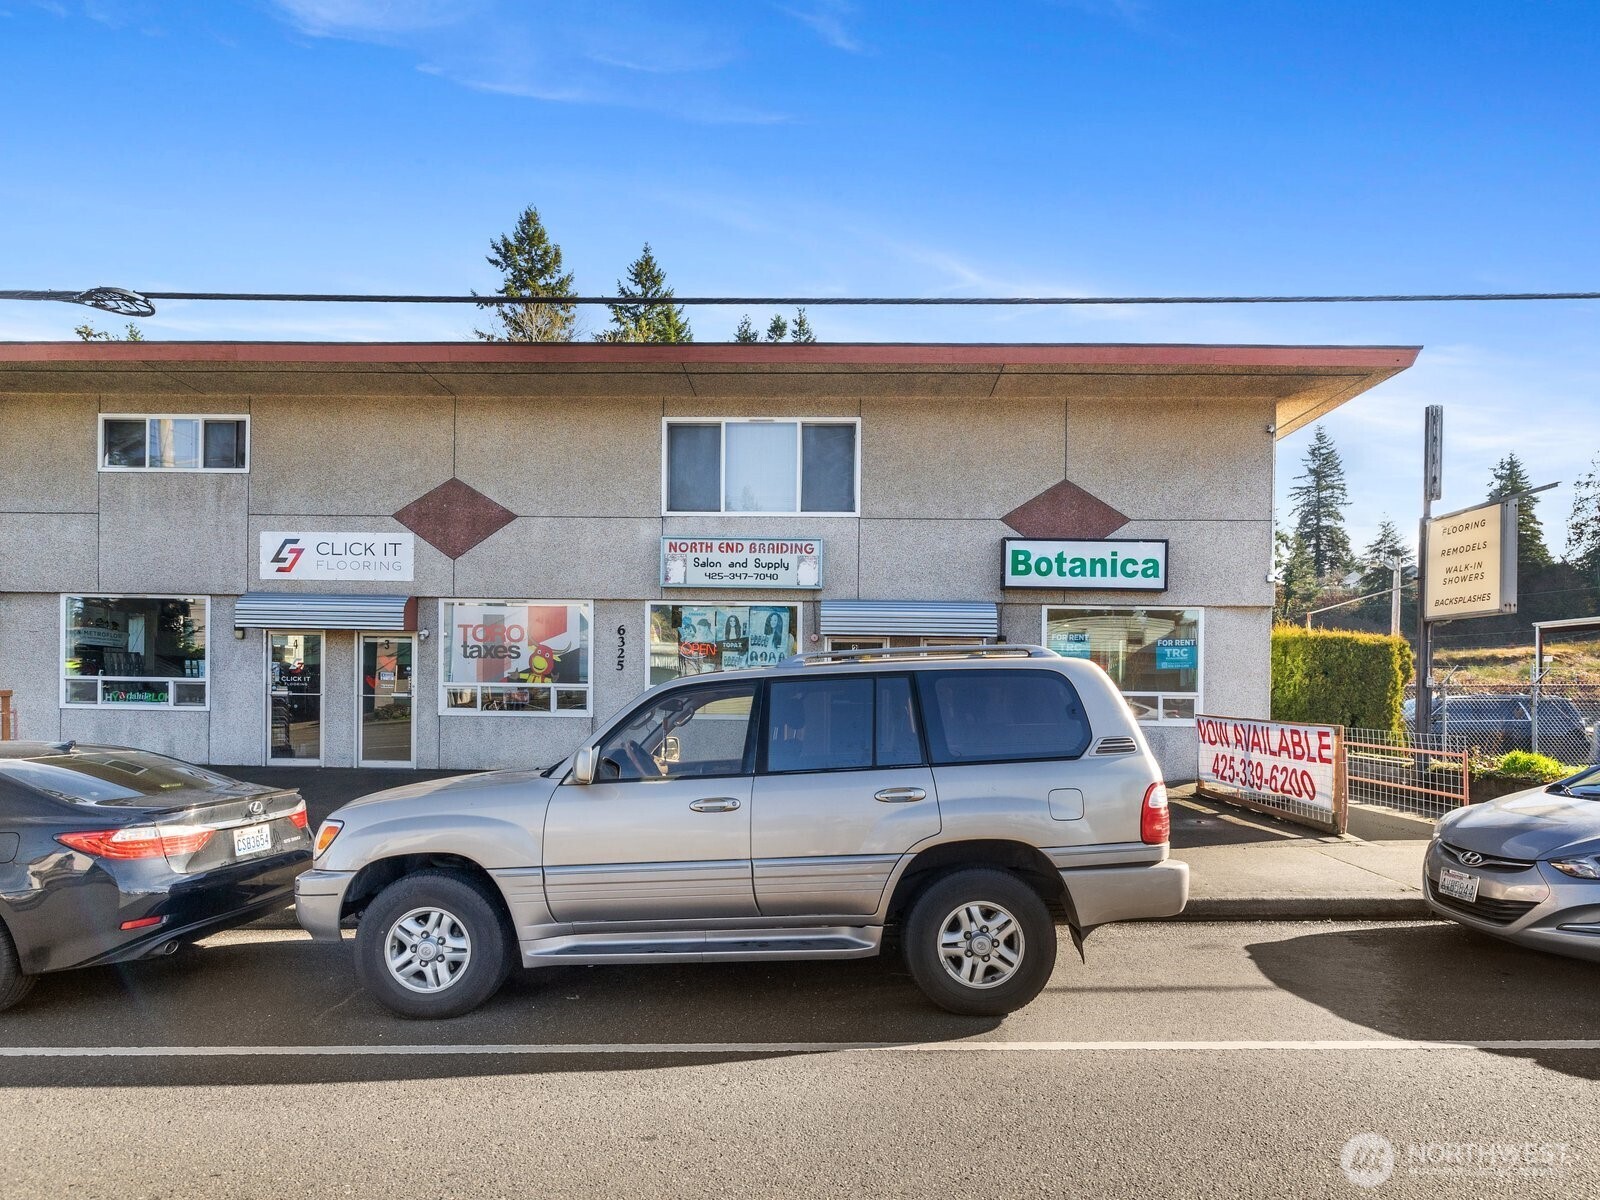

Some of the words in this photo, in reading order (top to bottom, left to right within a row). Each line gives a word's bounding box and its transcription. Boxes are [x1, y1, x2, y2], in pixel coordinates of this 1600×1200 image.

[1442, 519, 1486, 536] FLOORING
[316, 541, 376, 556] CLICK
[384, 543, 402, 556] IT
[668, 541, 713, 553] NORTH
[718, 542, 744, 554] END
[749, 543, 815, 555] BRAIDING
[1441, 541, 1487, 557] REMODELS
[316, 560, 402, 571] FLOORING
[693, 557, 722, 568] Salon
[728, 558, 748, 568] and
[754, 558, 789, 571] Supply
[1011, 549, 1160, 579] Botanica
[1445, 561, 1483, 575] WALK-IN
[704, 572, 779, 581] 425-347-7040
[1442, 572, 1485, 586] SHOWERS
[1434, 593, 1491, 607] BACKSPLASHES
[457, 624, 525, 643] TORO
[1051, 633, 1067, 641] FOR
[1069, 633, 1090, 641] RENT
[293, 639, 298, 649] 4
[384, 640, 390, 650] 3
[616, 624, 626, 671] 6325
[680, 641, 717, 656] OPEN
[1157, 639, 1173, 647] FOR
[1175, 639, 1195, 647] RENT
[461, 641, 521, 660] taxes
[1164, 648, 1188, 657] TRC
[1197, 718, 1230, 748] NOW
[1234, 723, 1332, 764] AVAILABLE
[1212, 753, 1316, 801] 425-339-6200
[237, 833, 268, 852] CSB3654
